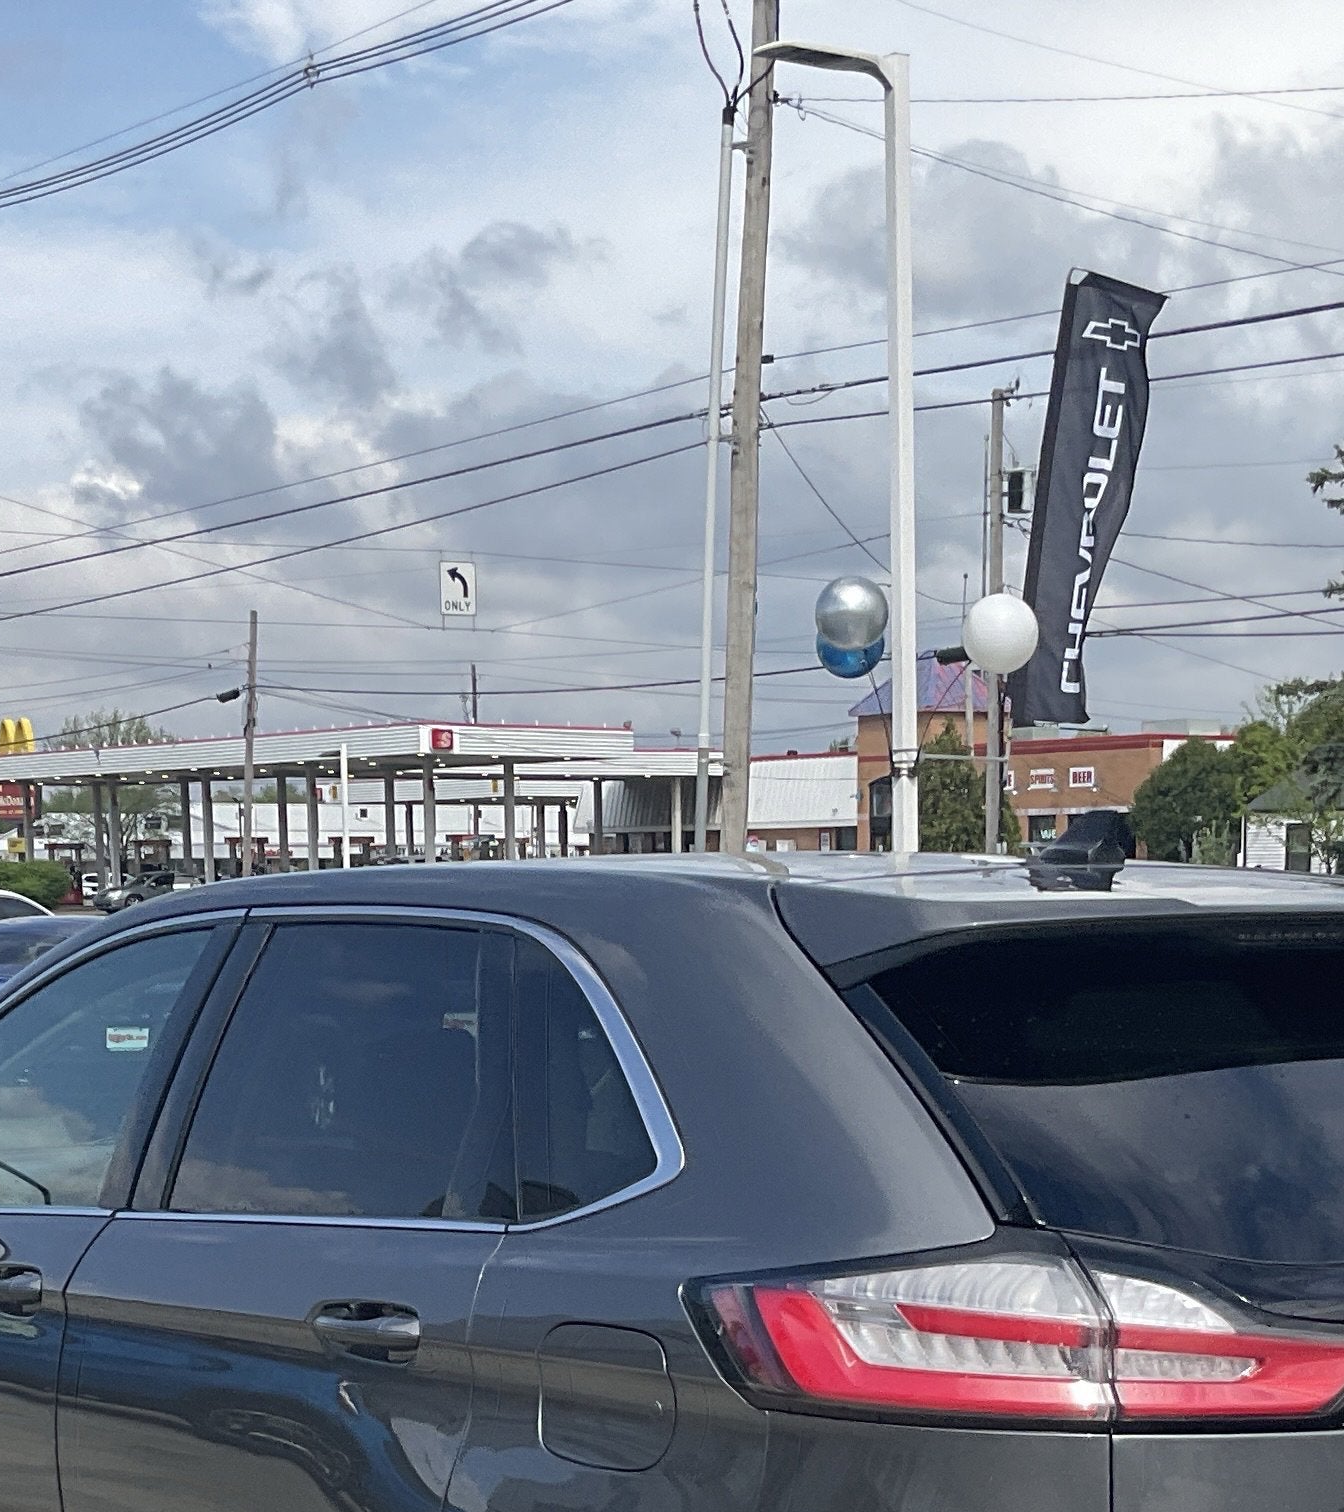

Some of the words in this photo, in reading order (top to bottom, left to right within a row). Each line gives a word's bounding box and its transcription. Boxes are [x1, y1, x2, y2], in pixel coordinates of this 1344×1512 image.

[1061, 367, 1126, 693] CHEVROLET
[444, 600, 471, 611] ONLY
[1072, 771, 1093, 785] BEER
